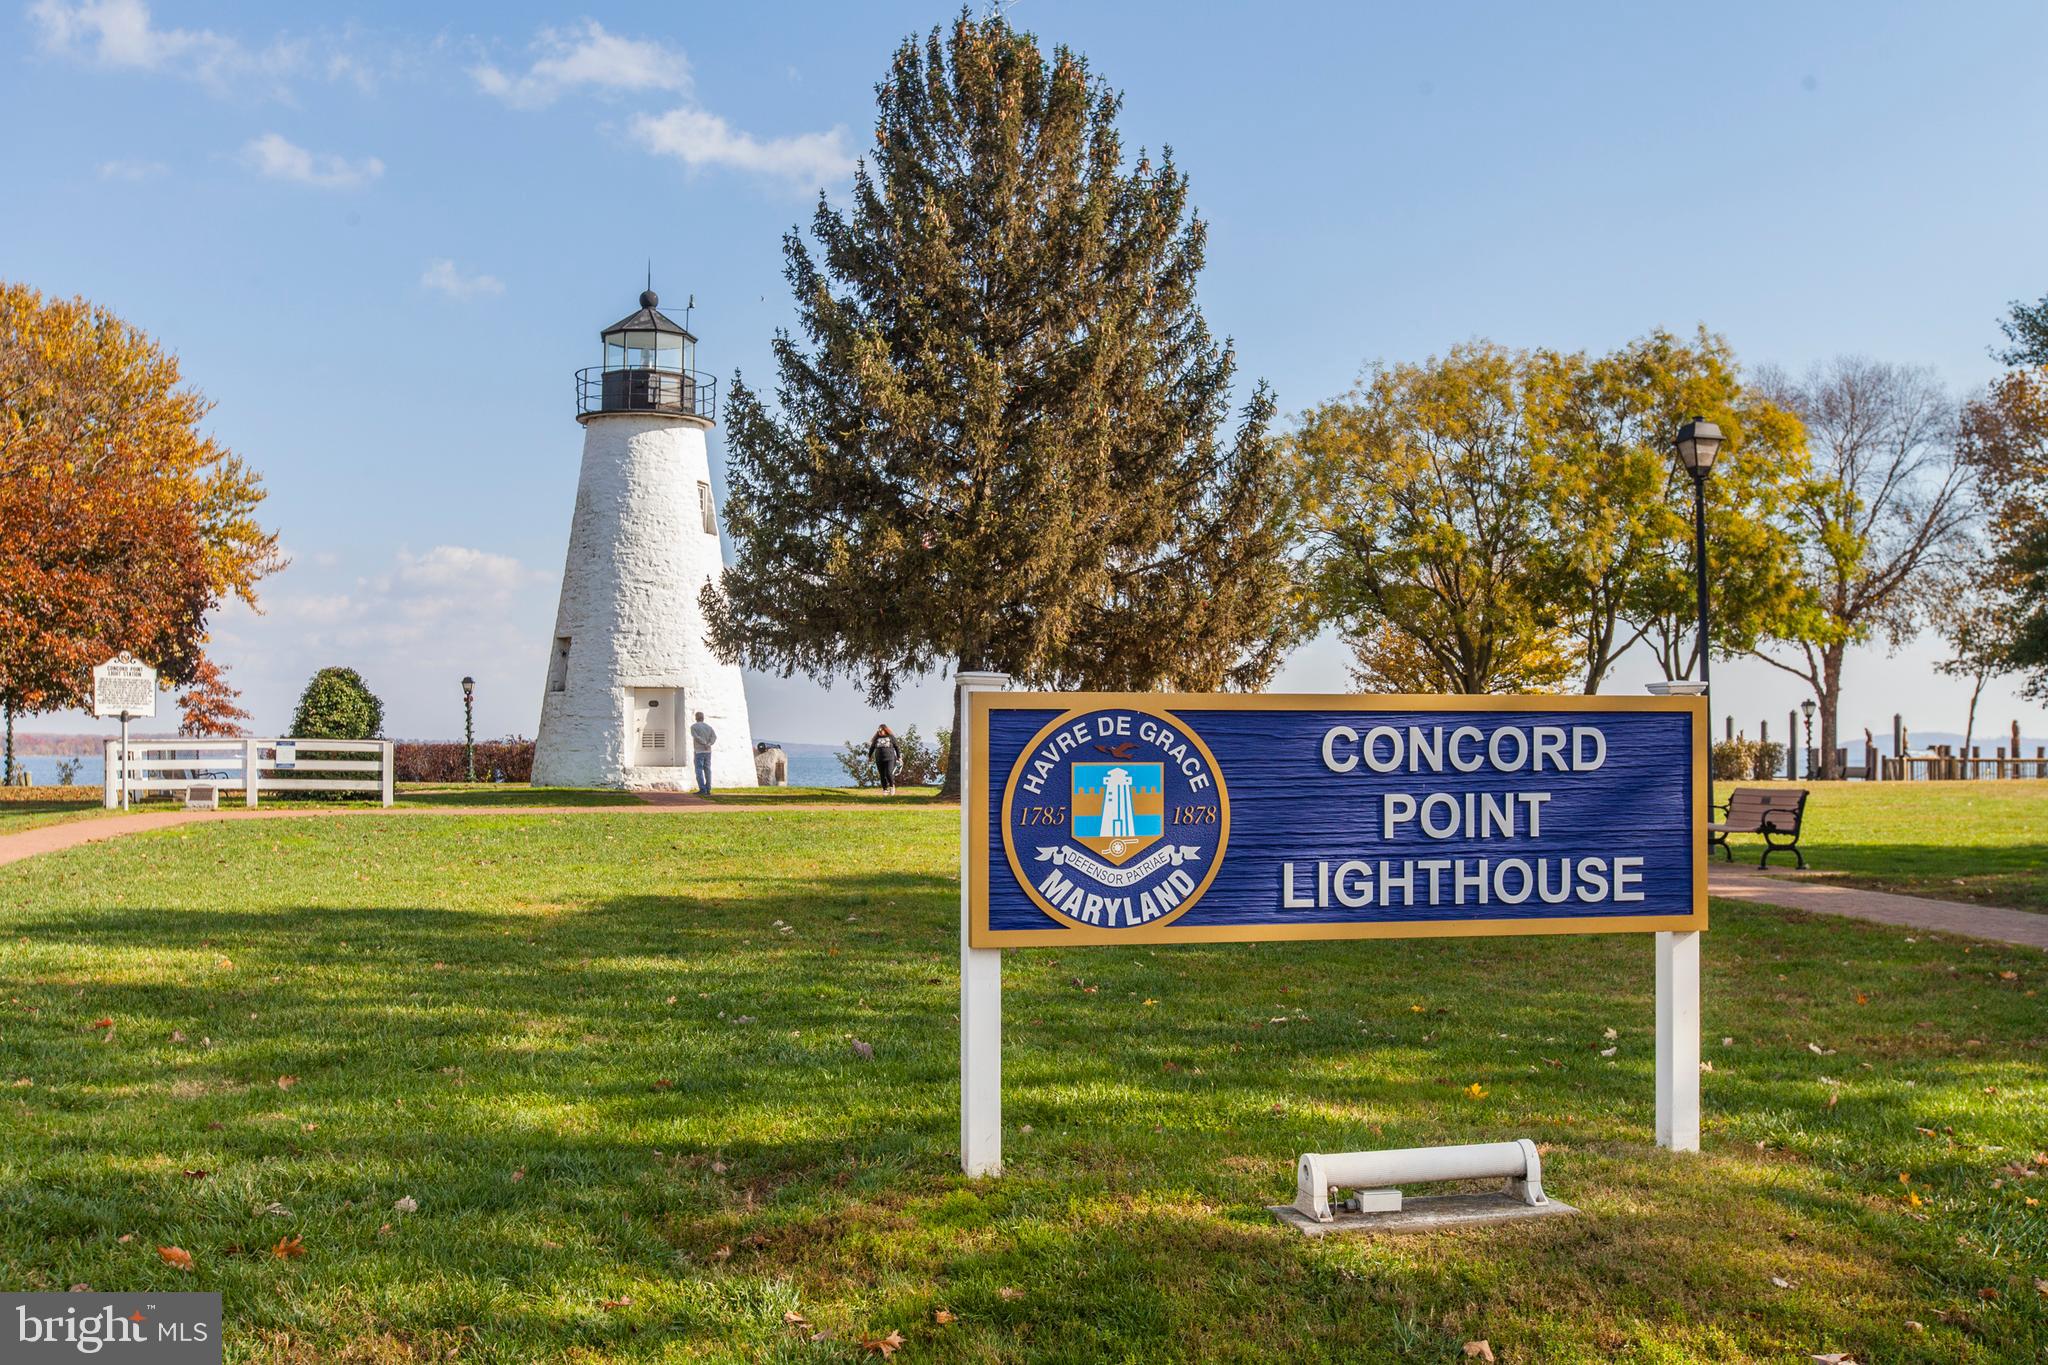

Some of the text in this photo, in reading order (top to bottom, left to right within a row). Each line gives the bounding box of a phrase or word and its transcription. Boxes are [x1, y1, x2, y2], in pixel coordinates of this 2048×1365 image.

[1023, 716, 1209, 795] HAVRE DE GRACE
[1322, 725, 1607, 773] CONCORD
[1020, 806, 1067, 826] 1785
[1172, 805, 1217, 825] 1878
[1384, 792, 1552, 839] POINT
[1067, 851, 1169, 885] DEFENSOR PATRIAE
[1283, 856, 1646, 909] LIGHTHOUSE
[1038, 868, 1195, 927] MARYLAND
